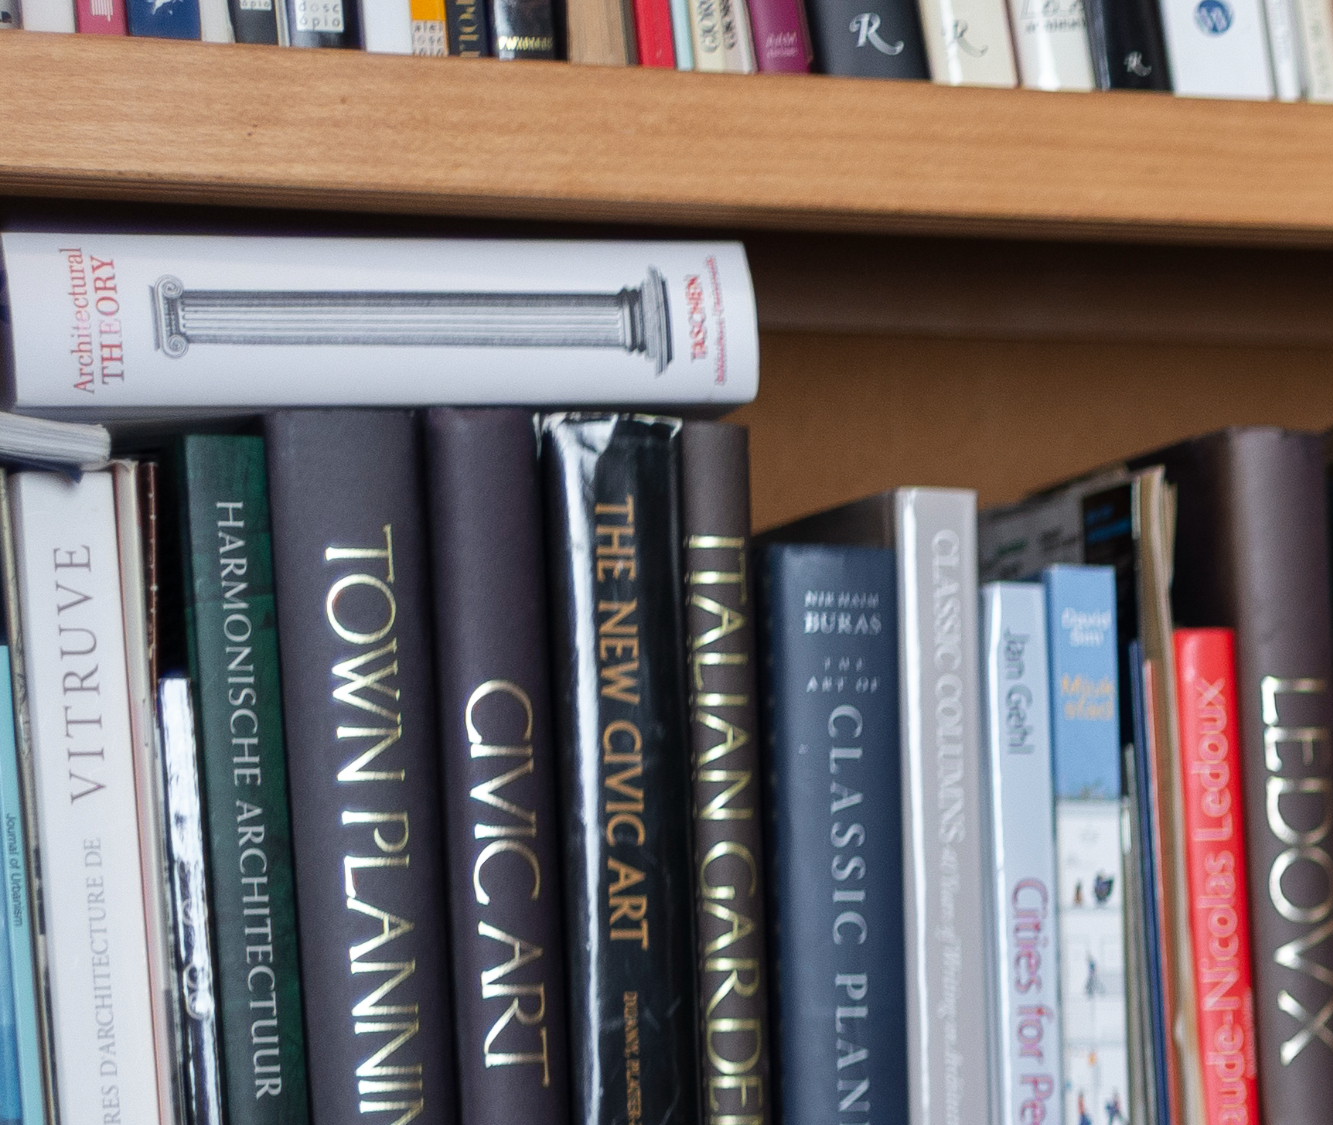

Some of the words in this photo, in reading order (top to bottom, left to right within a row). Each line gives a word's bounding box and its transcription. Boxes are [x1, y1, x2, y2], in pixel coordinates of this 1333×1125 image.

[60, 246, 96, 396] Architectural
[94, 255, 126, 384] THEORY
[684, 274, 707, 364] TASCHEN
[594, 495, 636, 582] THE
[931, 529, 962, 671] CLASSIC
[53, 544, 107, 806] VITRUVE
[216, 501, 262, 787] HARMONISCHE
[325, 523, 406, 783] TOWN
[598, 599, 641, 704] NEW
[687, 535, 756, 822] ITALIAN
[804, 611, 882, 635] BURAS
[1004, 627, 1031, 681] Jan
[602, 721, 647, 847] CIVIC
[934, 674, 966, 845] COLUMNS
[1006, 684, 1036, 755] Gehl
[1192, 677, 1235, 842] Ledoux
[6, 812, 18, 854] Journal
[82, 837, 103, 869] DE
[465, 680, 541, 906] CIVIC
[827, 705, 868, 946] CLASSIC
[11, 870, 24, 927] Urbanism
[236, 799, 283, 1100] ARCHITECTUUR
[608, 859, 650, 950] ART
[1012, 878, 1050, 996] Cities
[88, 876, 121, 1077] D'ARCHITECTURE
[478, 920, 551, 1088] ART
[1016, 1004, 1055, 1064] for
